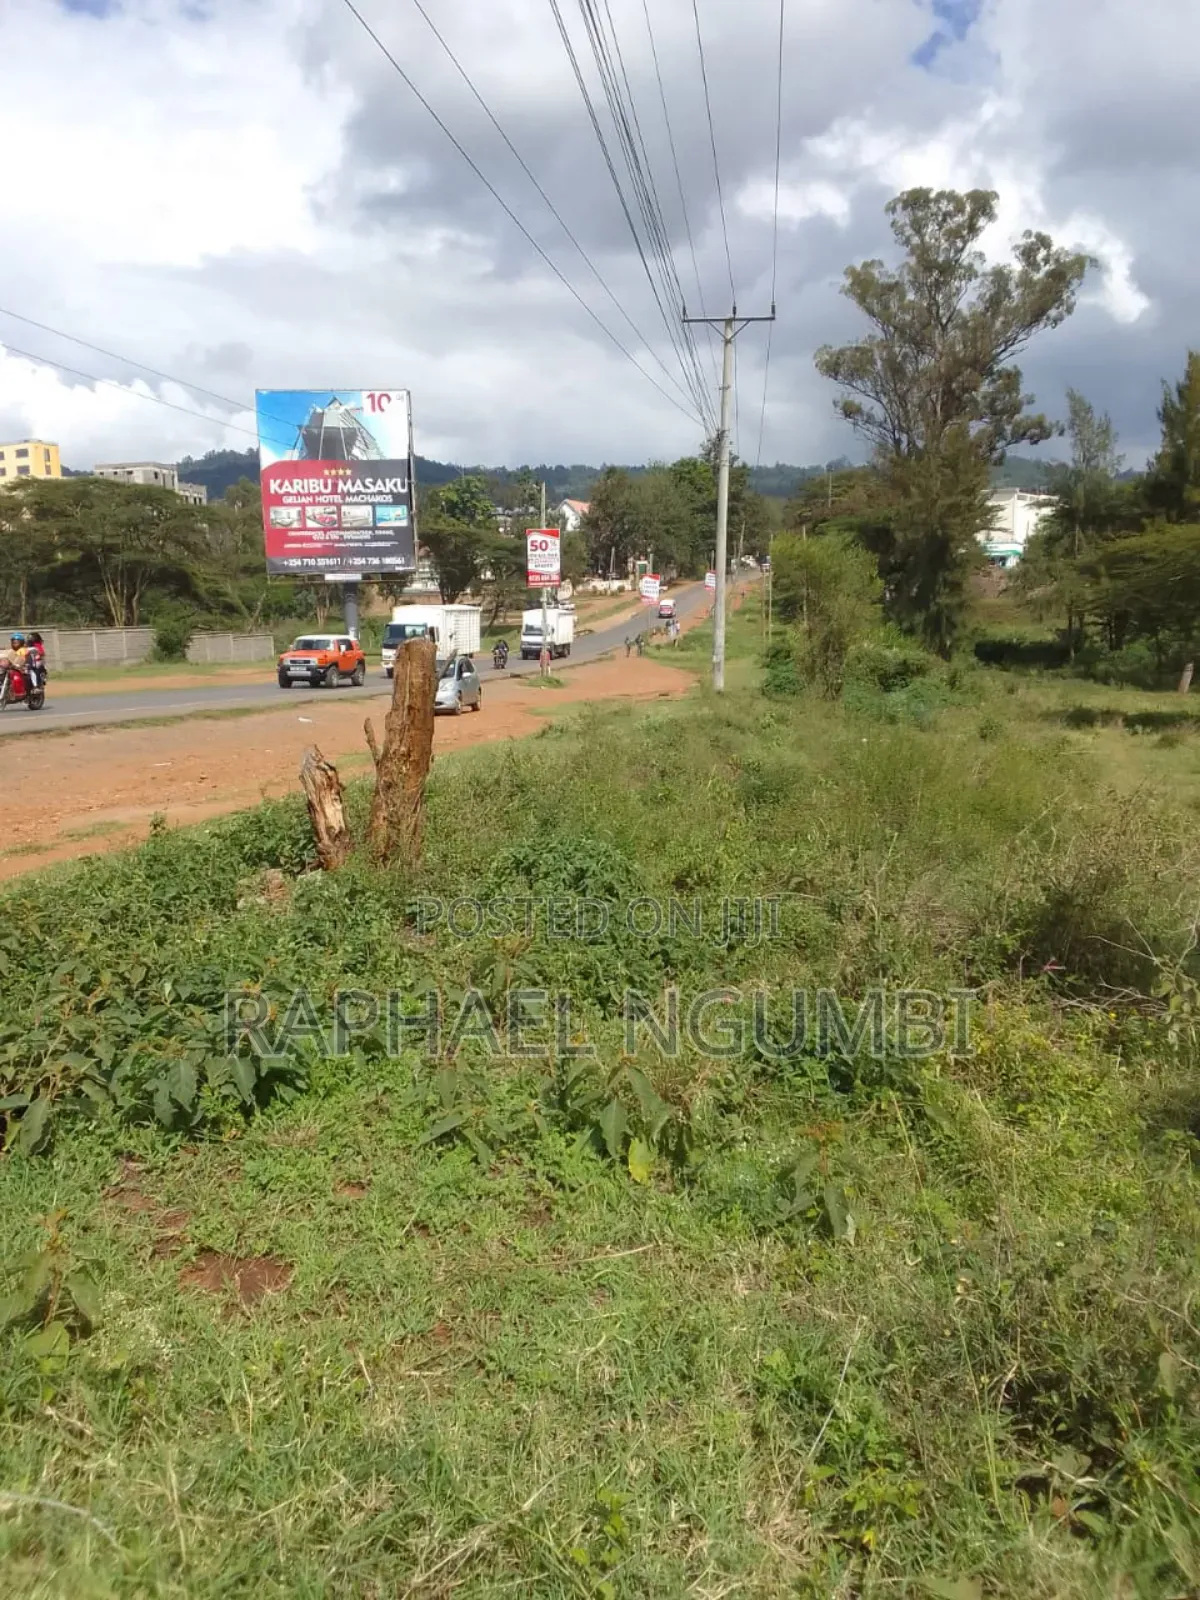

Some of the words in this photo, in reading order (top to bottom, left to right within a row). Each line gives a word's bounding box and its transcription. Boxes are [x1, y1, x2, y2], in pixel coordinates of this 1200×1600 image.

[269, 478, 332, 494] KARIBU
[337, 478, 408, 493] MASAKU
[315, 494, 342, 504] HOTEL
[345, 494, 393, 503] MACHAKOS
